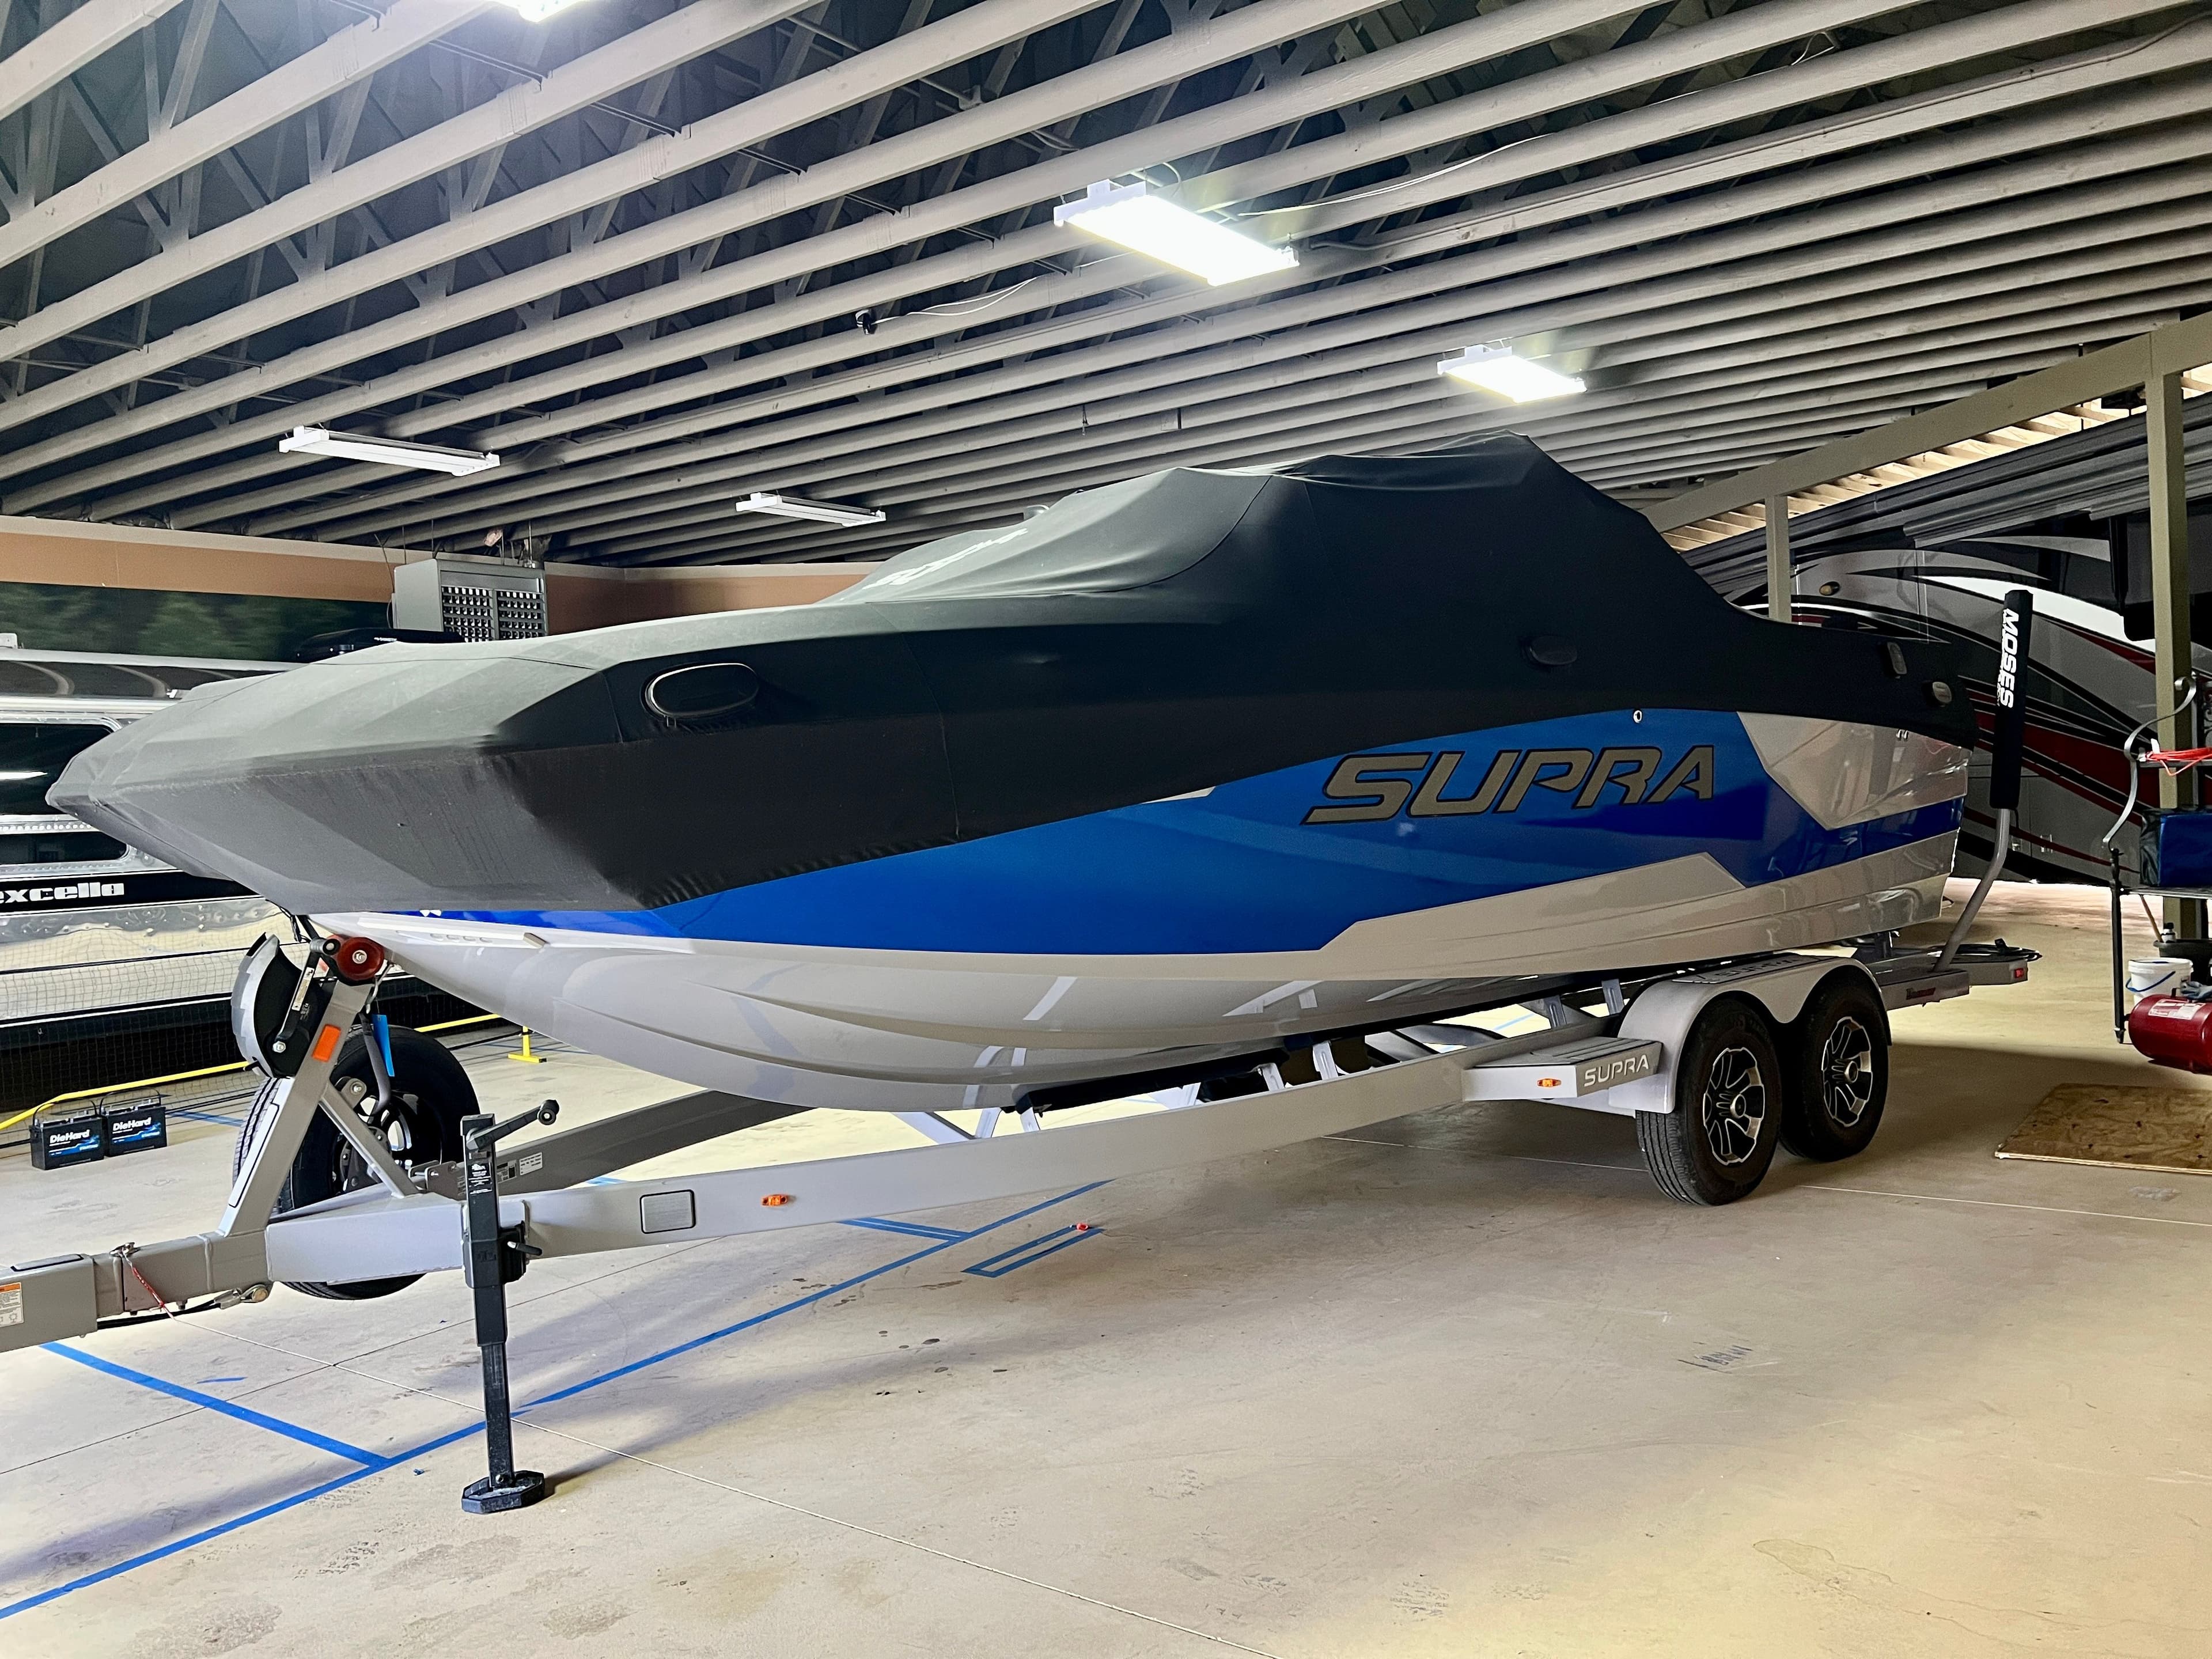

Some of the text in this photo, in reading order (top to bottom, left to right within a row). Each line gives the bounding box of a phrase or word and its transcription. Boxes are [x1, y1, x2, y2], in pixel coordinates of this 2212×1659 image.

[1999, 608, 2019, 708] MOSES
[1300, 745, 1714, 825] SUPRA
[0, 882, 124, 904] xcella
[1584, 1054, 1649, 1087] SUPRA
[50, 1130, 90, 1143] DieHard
[112, 1117, 151, 1131] DieHard
